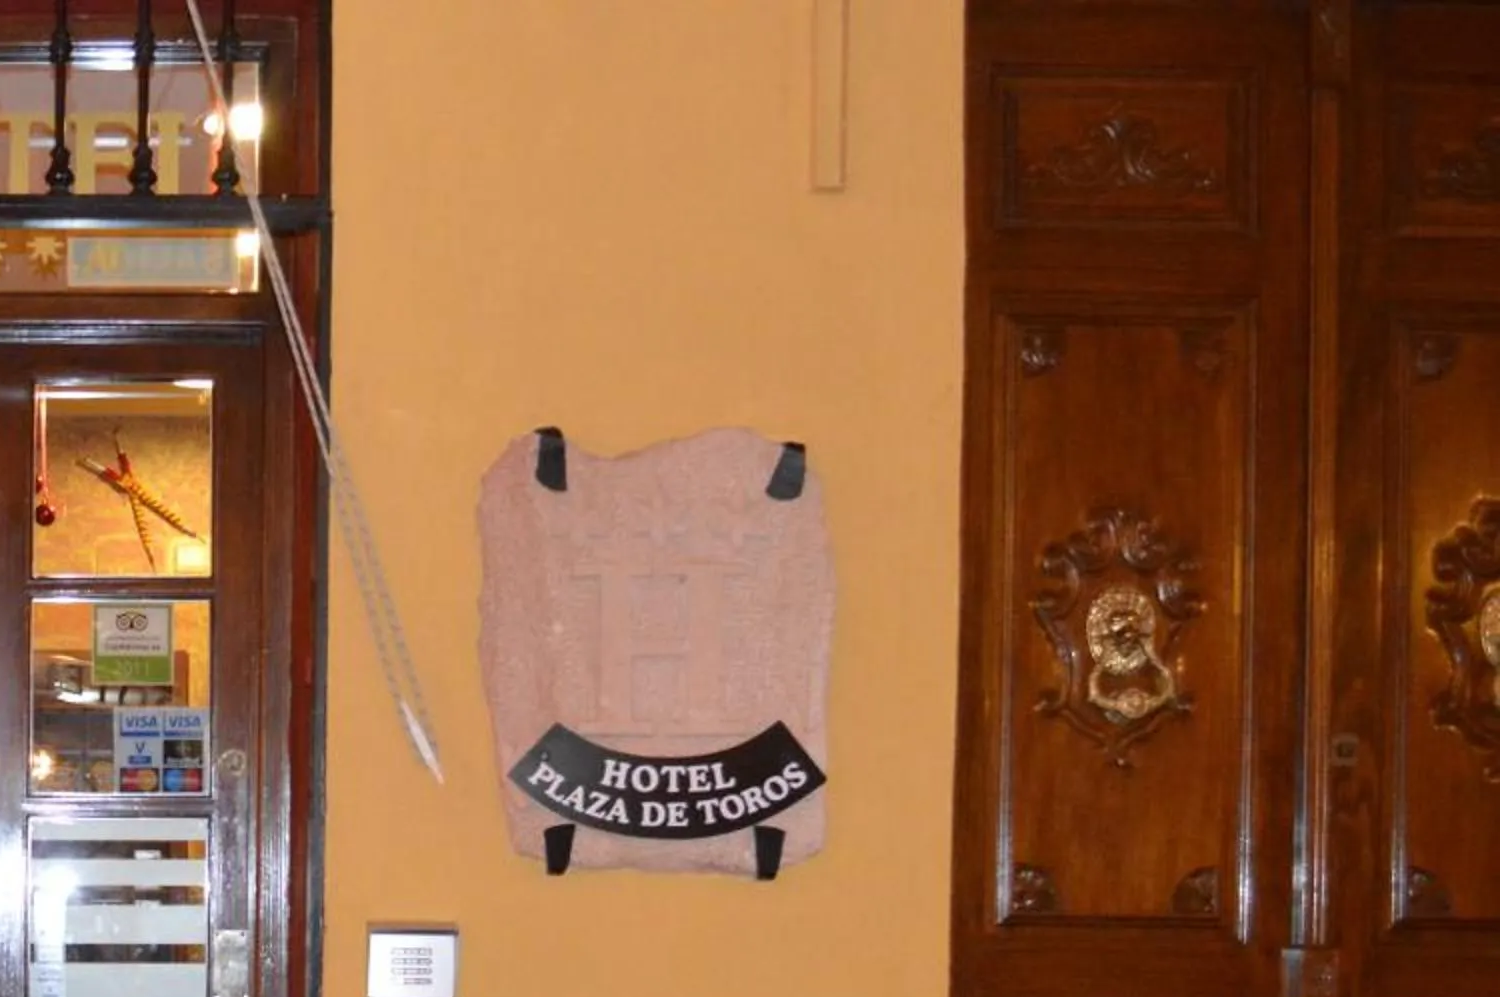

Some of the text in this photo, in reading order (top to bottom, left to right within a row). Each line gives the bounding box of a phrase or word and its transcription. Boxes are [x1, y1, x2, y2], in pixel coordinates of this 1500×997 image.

[125, 715, 157, 728] VISA
[168, 715, 201, 728] VISA
[601, 759, 737, 794] HOTEL
[527, 761, 808, 828] PLAZA DE TOROS
